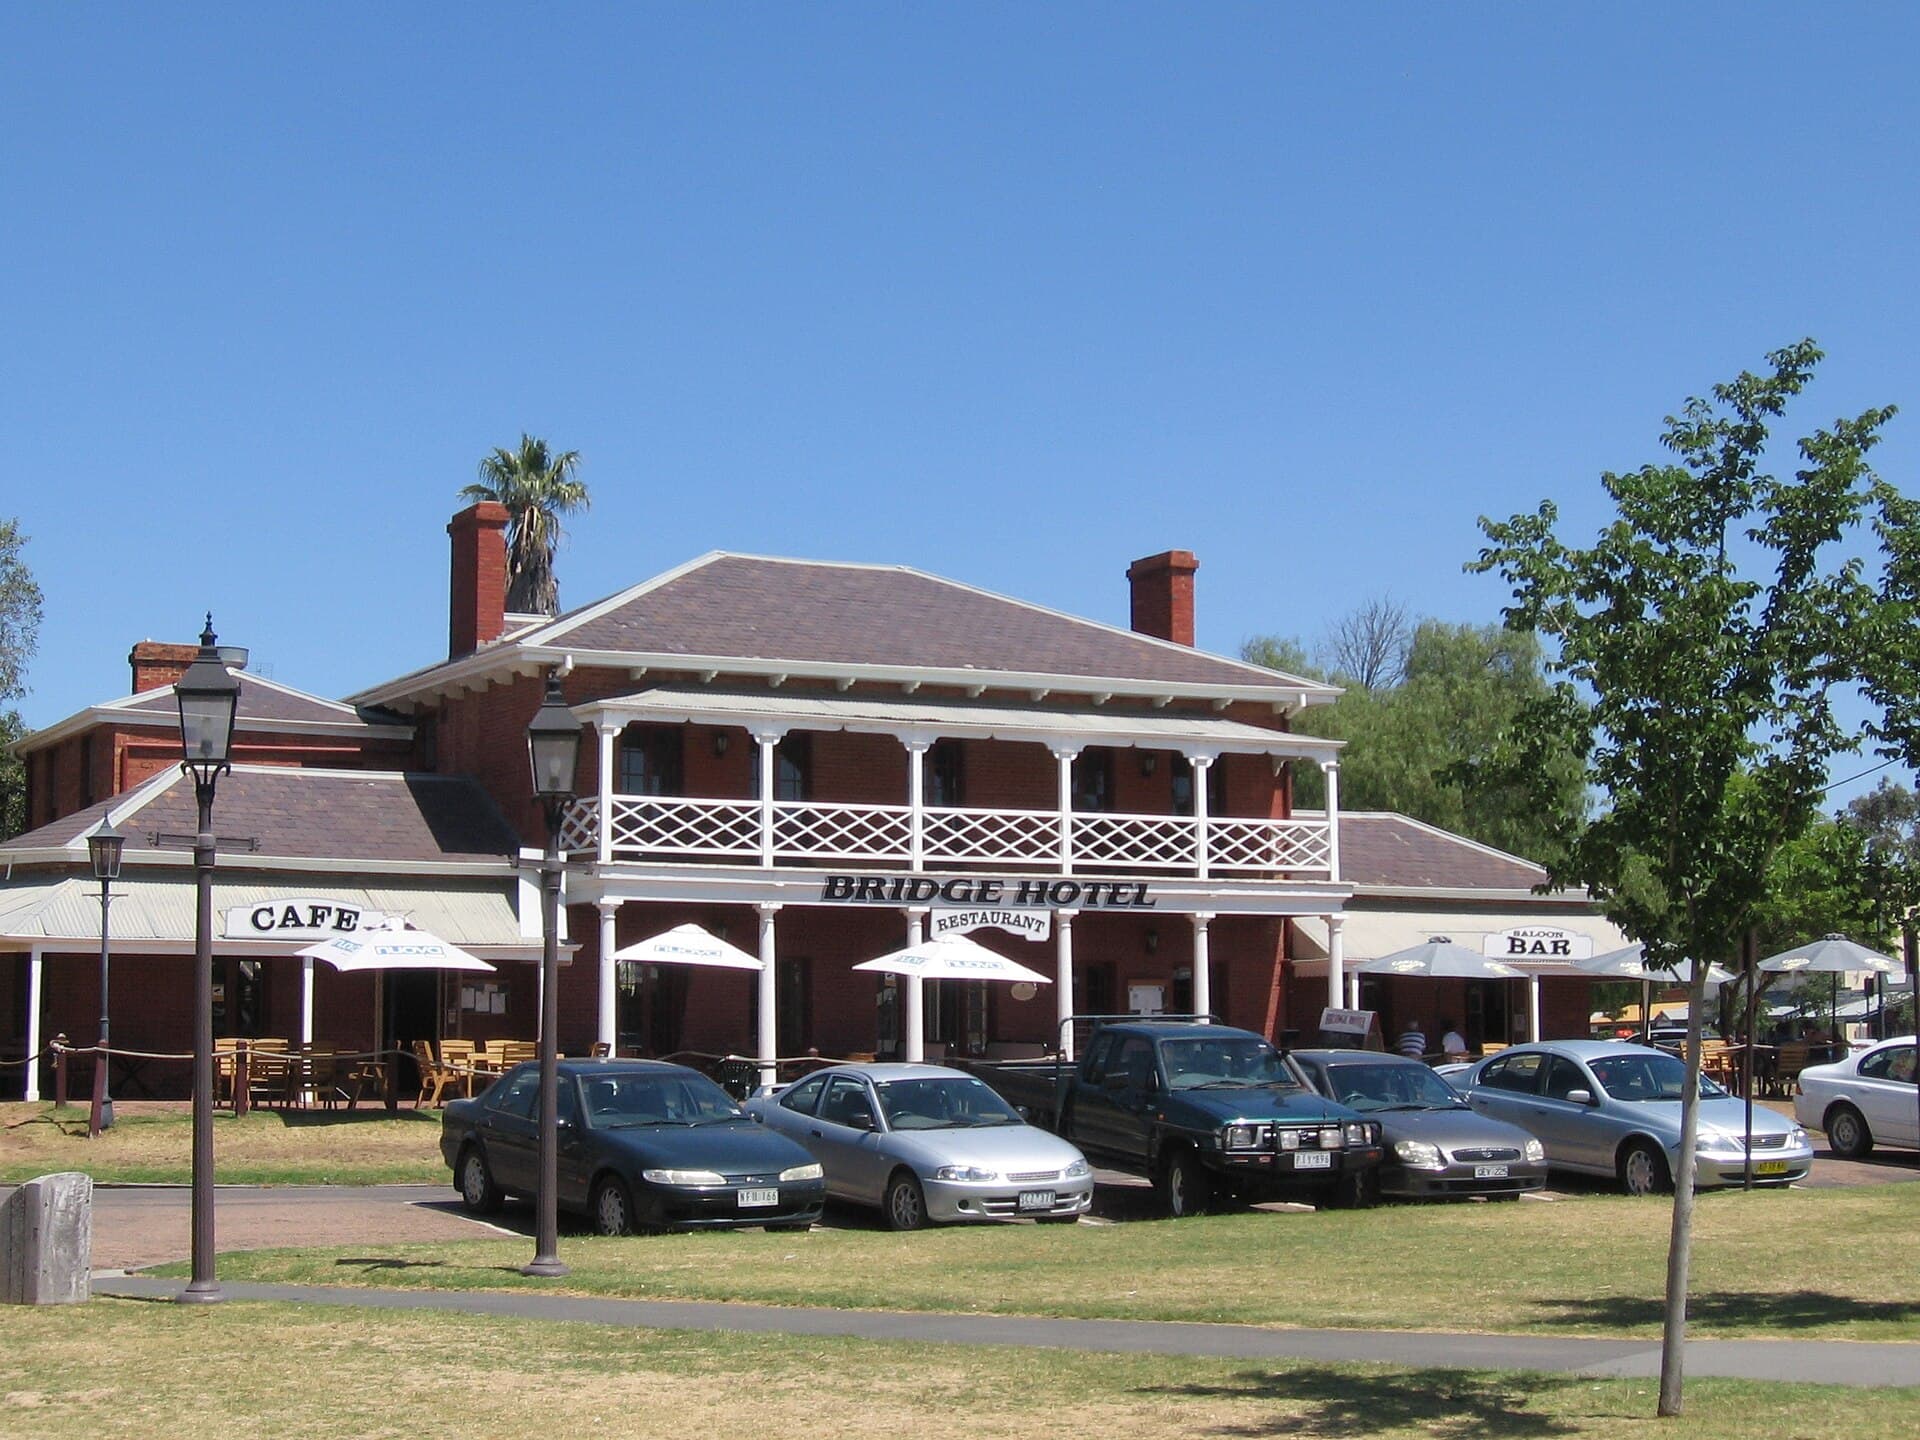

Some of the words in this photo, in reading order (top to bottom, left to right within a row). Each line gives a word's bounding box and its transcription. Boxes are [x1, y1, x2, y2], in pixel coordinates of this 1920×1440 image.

[823, 875, 1005, 906] BRIDGE
[1012, 880, 1158, 908] HOTEL
[251, 905, 360, 932] CAFE
[936, 910, 1046, 933] RESTAURANT
[1513, 930, 1564, 938] SALOON
[1507, 936, 1571, 956] BAR
